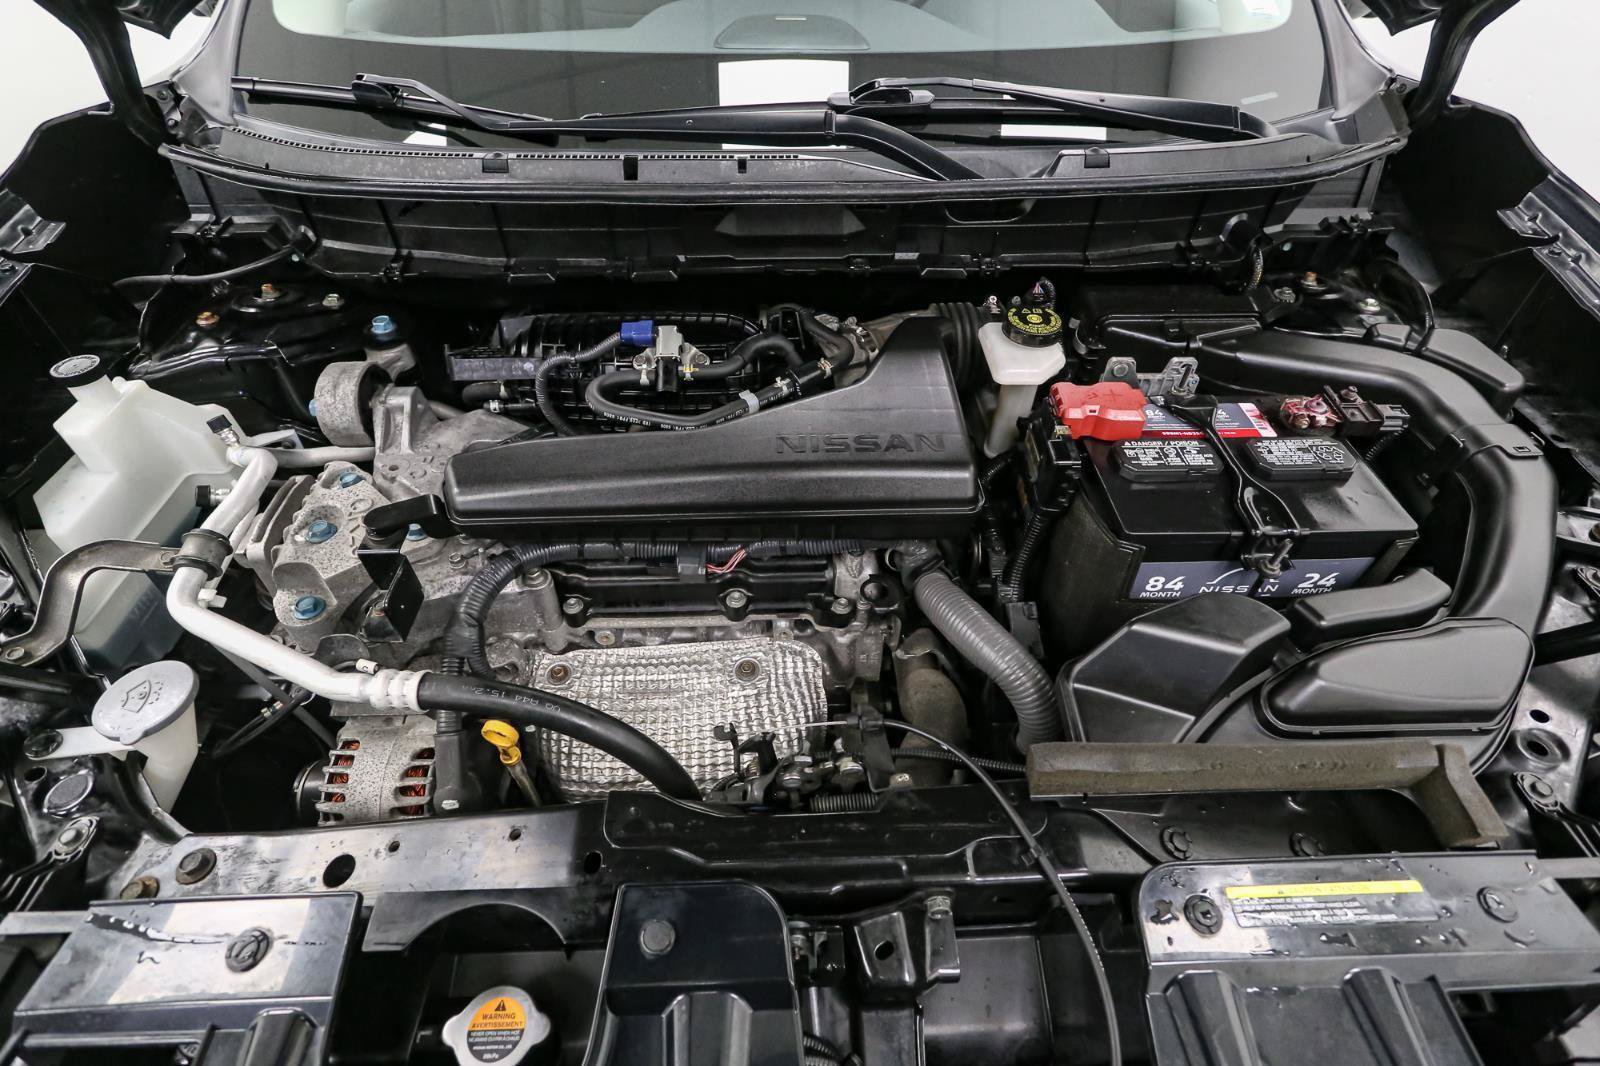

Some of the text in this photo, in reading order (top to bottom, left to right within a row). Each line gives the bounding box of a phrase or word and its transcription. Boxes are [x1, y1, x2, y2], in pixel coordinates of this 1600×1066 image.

[776, 433, 945, 453] NISSAN
[1145, 575, 1186, 592] 84
[1297, 572, 1342, 588] 24
[482, 1012, 515, 1020] WARNING
[471, 1021, 523, 1029] AVERTISSEMENT
